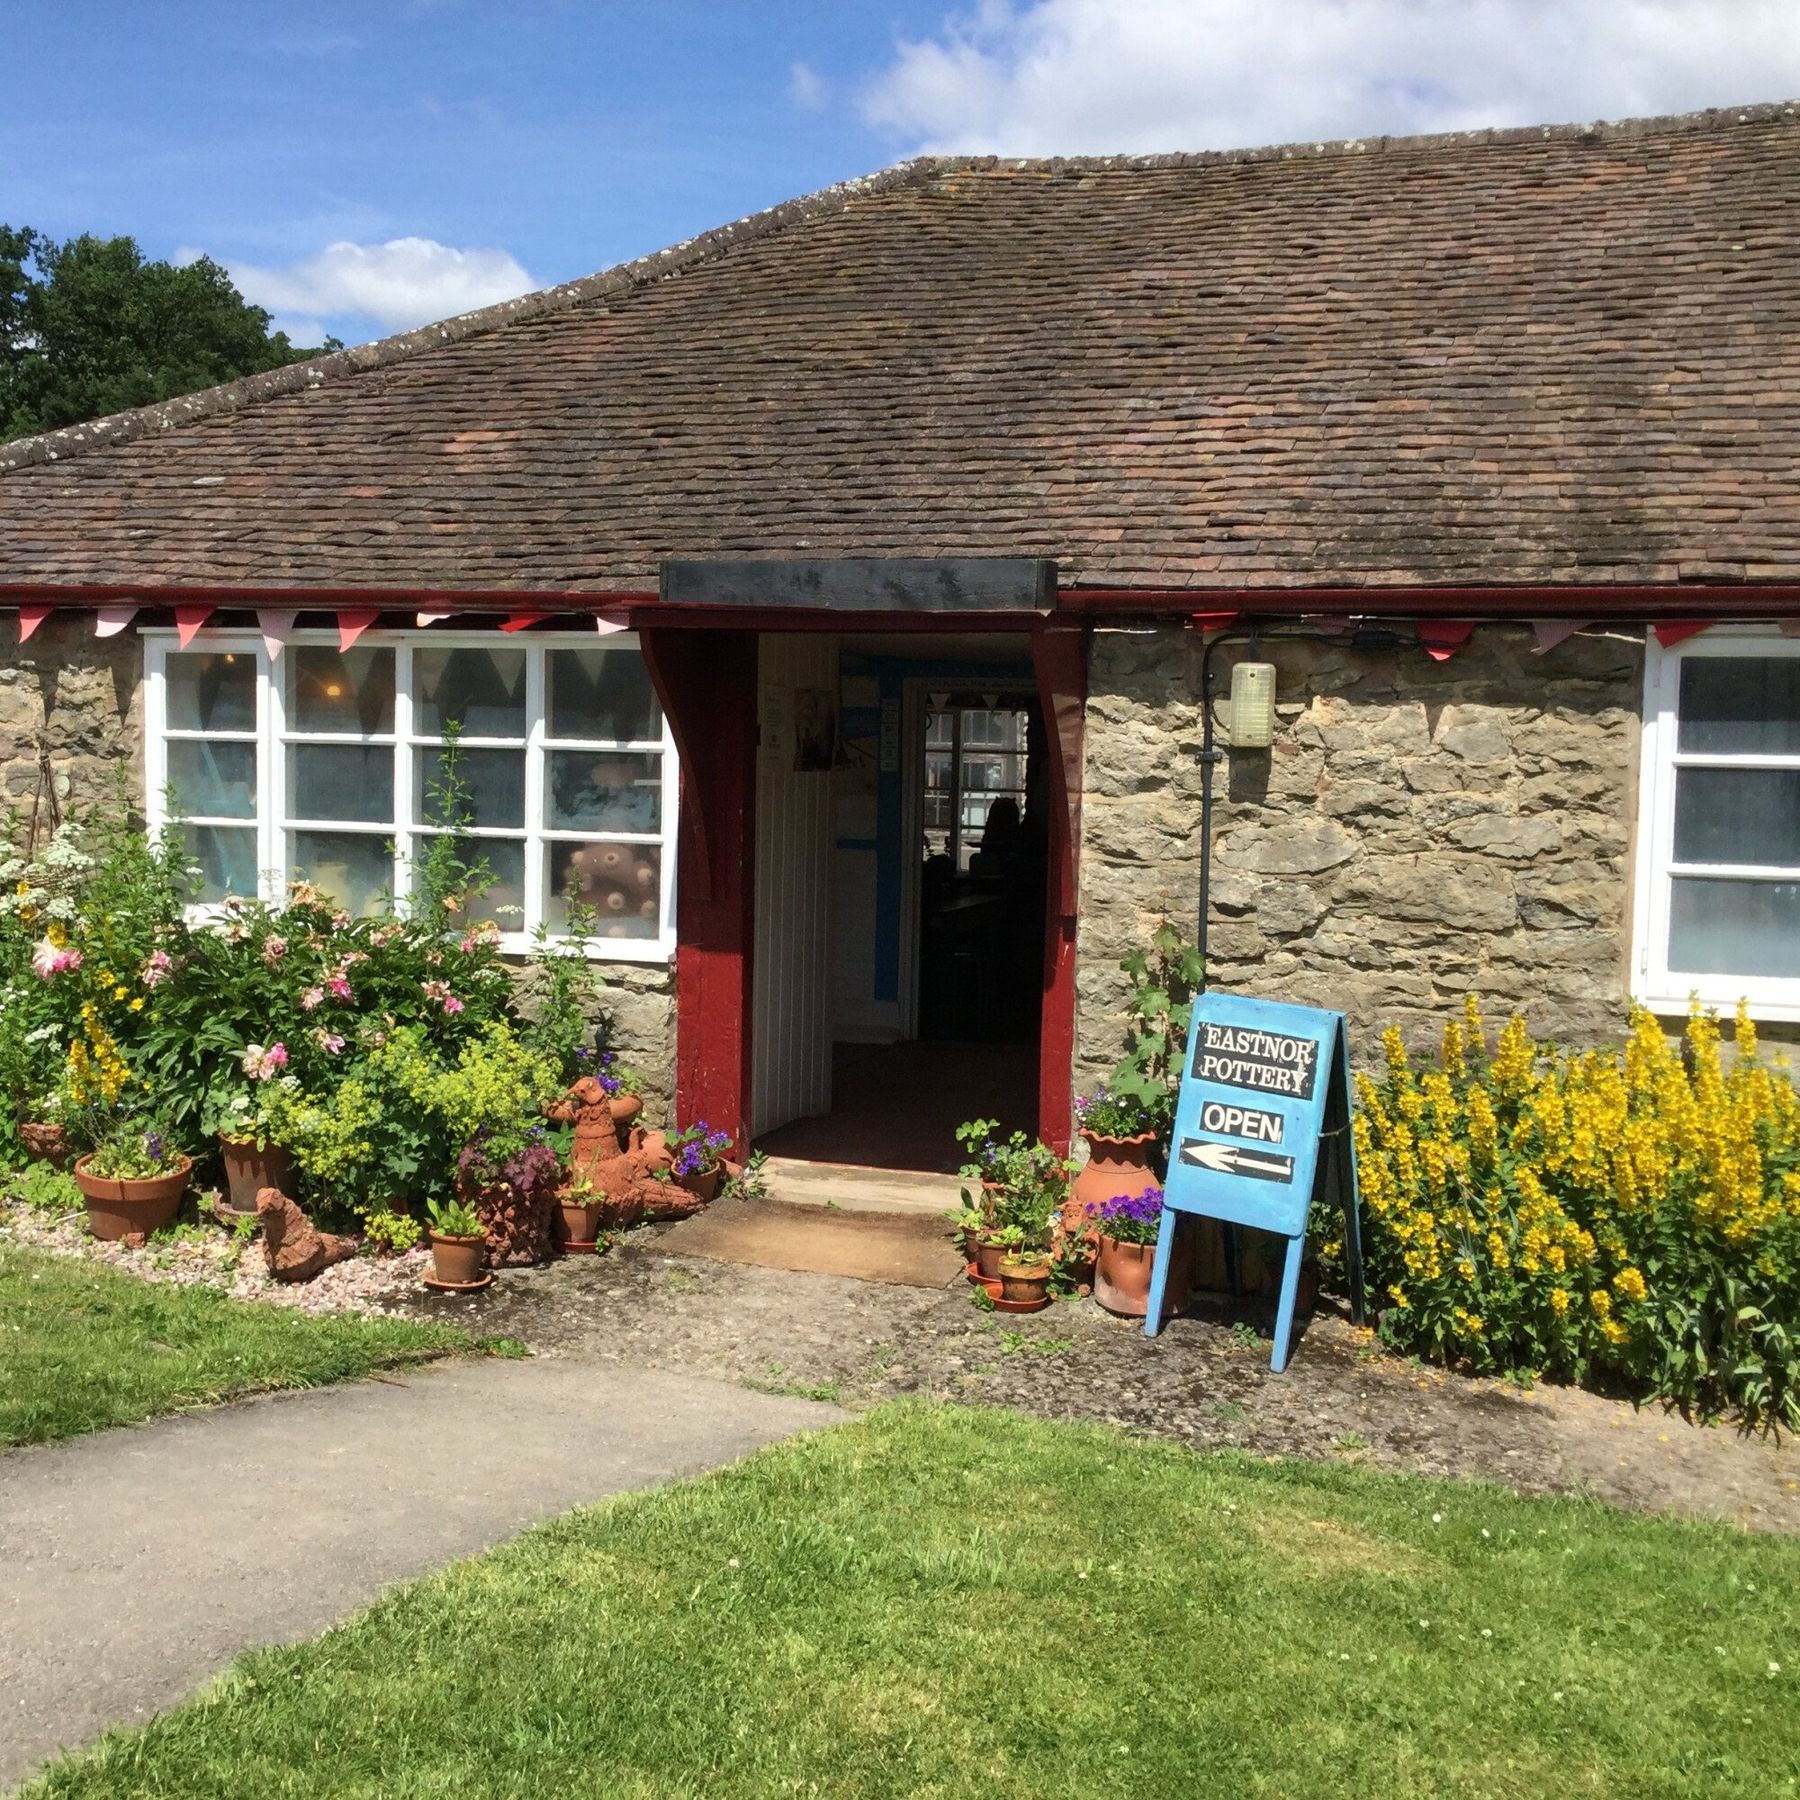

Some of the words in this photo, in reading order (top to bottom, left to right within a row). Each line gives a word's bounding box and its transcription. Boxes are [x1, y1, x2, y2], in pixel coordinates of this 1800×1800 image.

[1204, 1026, 1313, 1064] EASTNOR
[1201, 1055, 1308, 1093] POTTERY
[1203, 1105, 1281, 1142] OPEN
